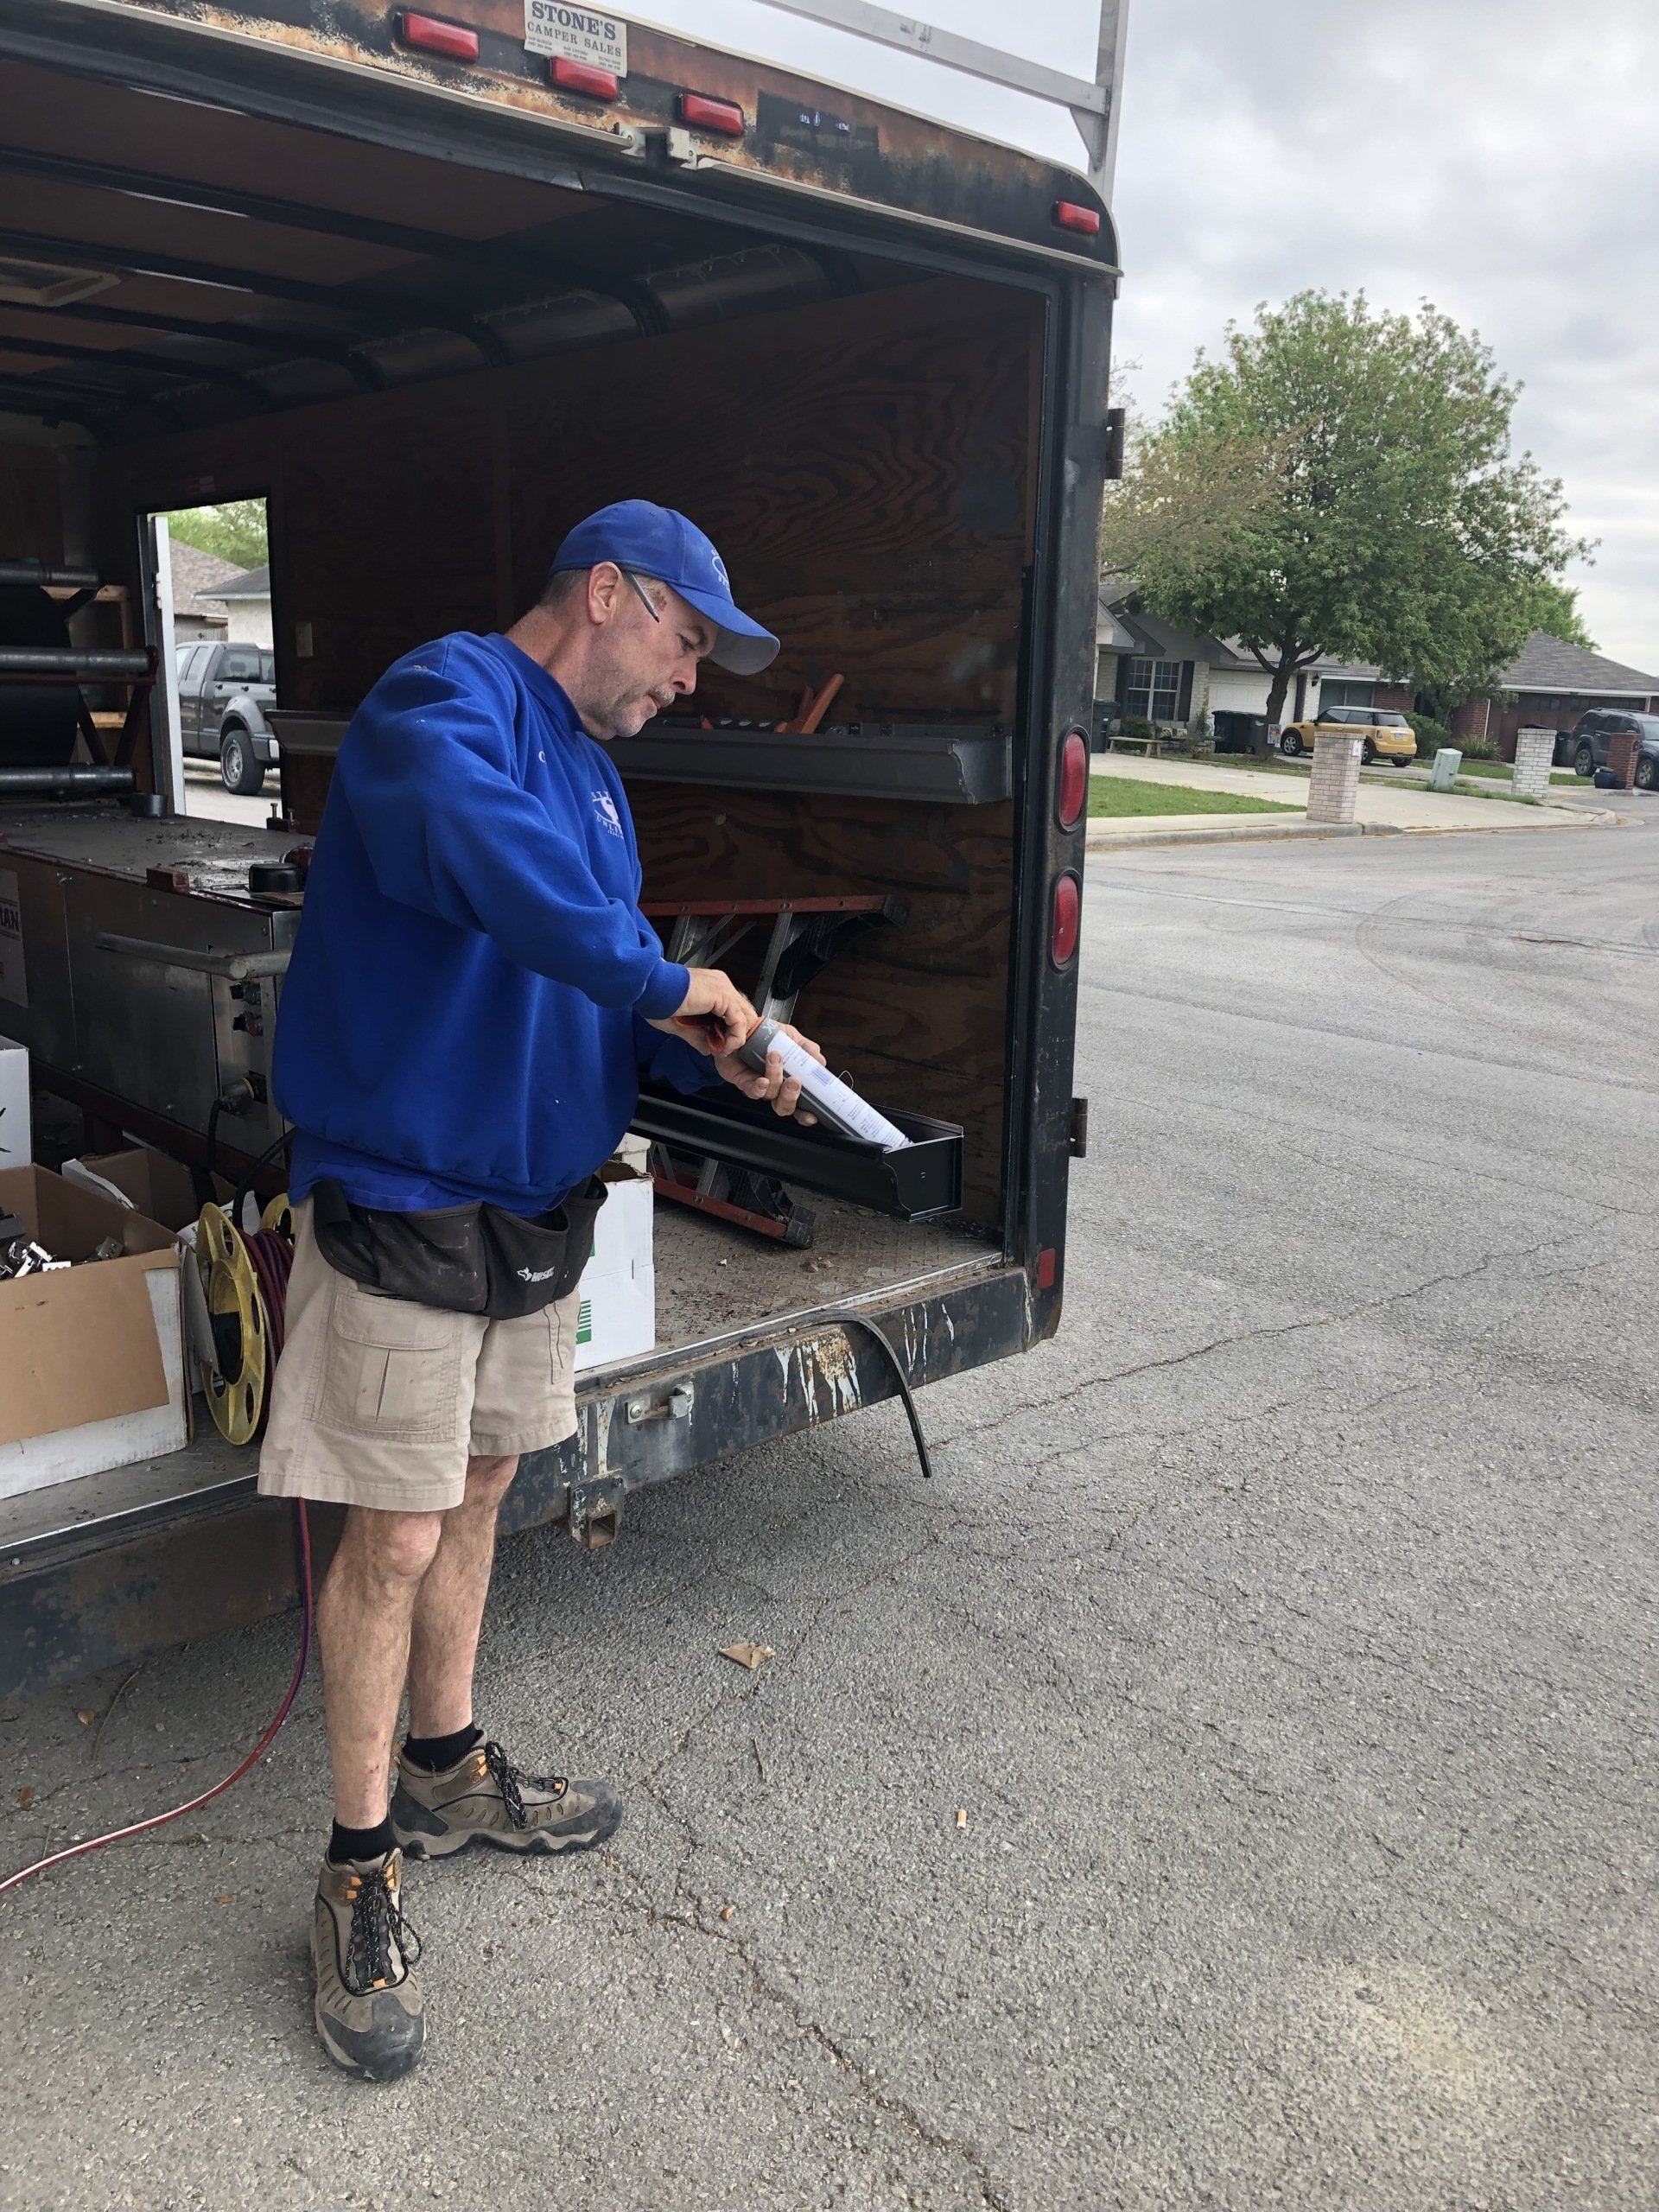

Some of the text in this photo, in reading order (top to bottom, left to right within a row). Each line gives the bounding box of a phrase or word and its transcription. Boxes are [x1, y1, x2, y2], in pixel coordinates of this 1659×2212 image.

[527, 22, 578, 45] CAMPER
[584, 37, 621, 57] SALES
[531, 1, 616, 41] STONE'S
